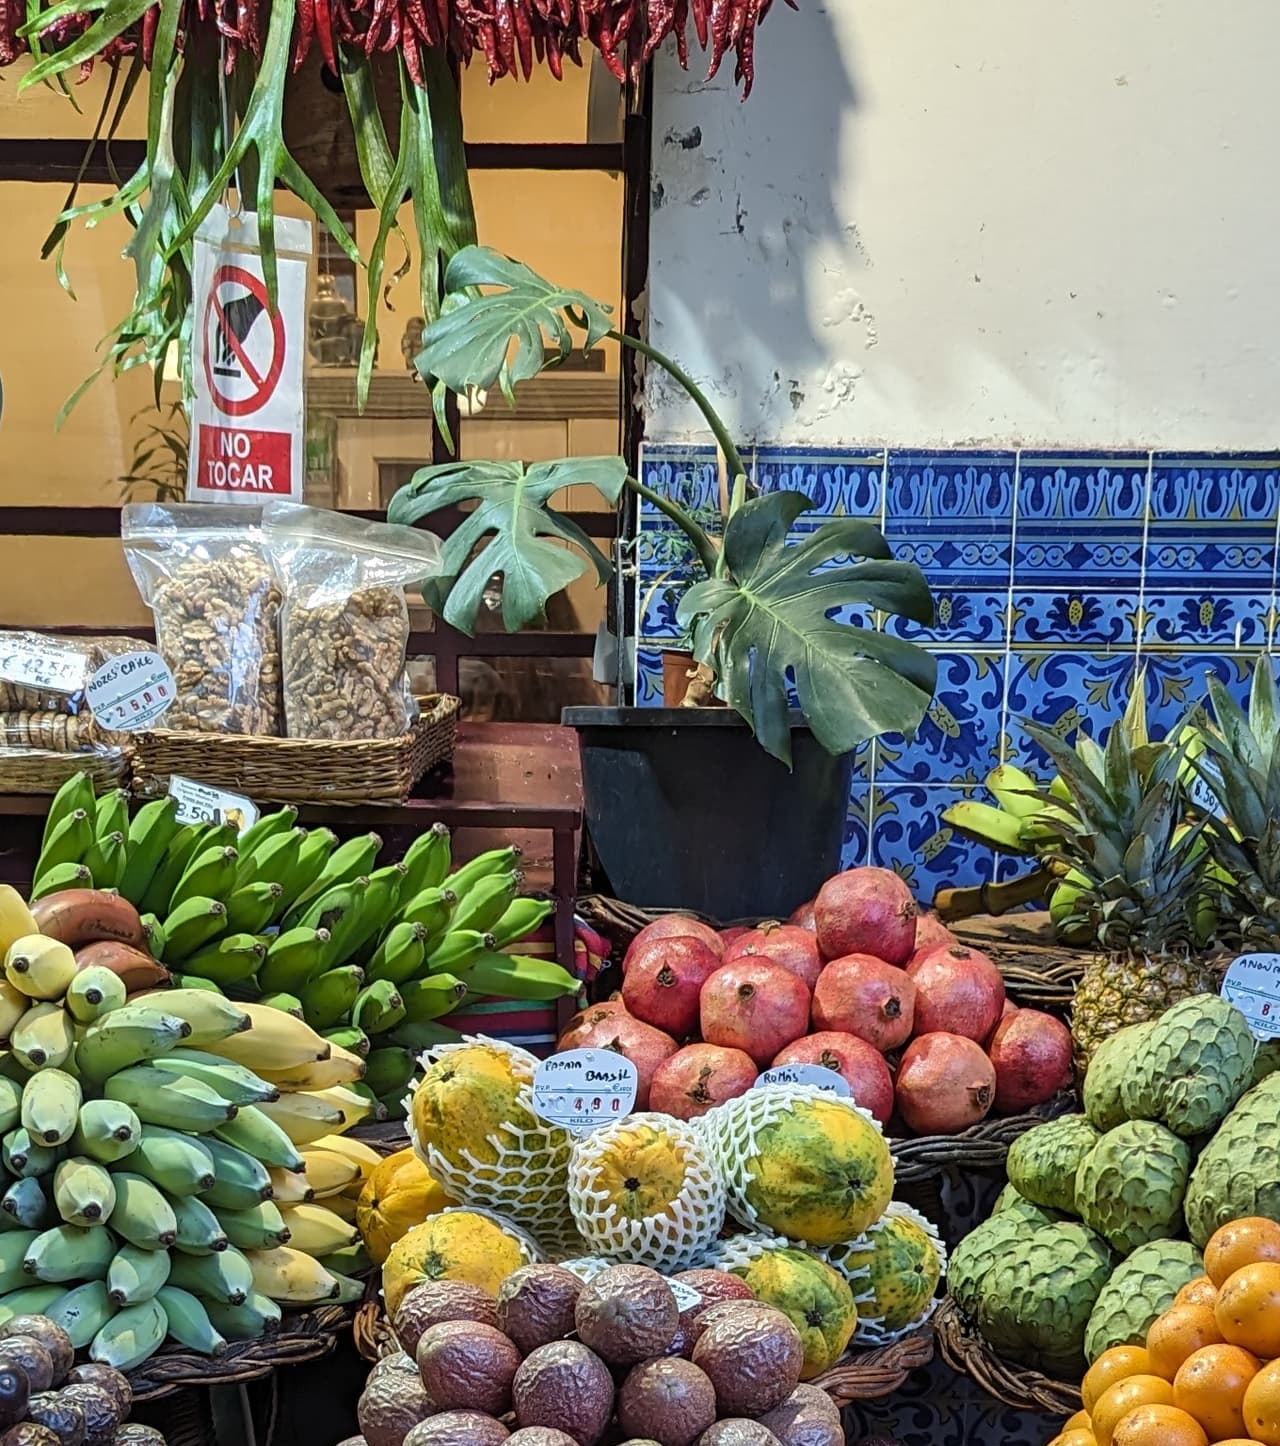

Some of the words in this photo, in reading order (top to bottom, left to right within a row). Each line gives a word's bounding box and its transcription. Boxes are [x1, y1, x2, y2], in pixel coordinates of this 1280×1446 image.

[220, 431, 251, 459] NO
[207, 460, 274, 490] TOCAR
[87, 667, 119, 693] NOZES
[574, 1096, 620, 1115] 4,90
